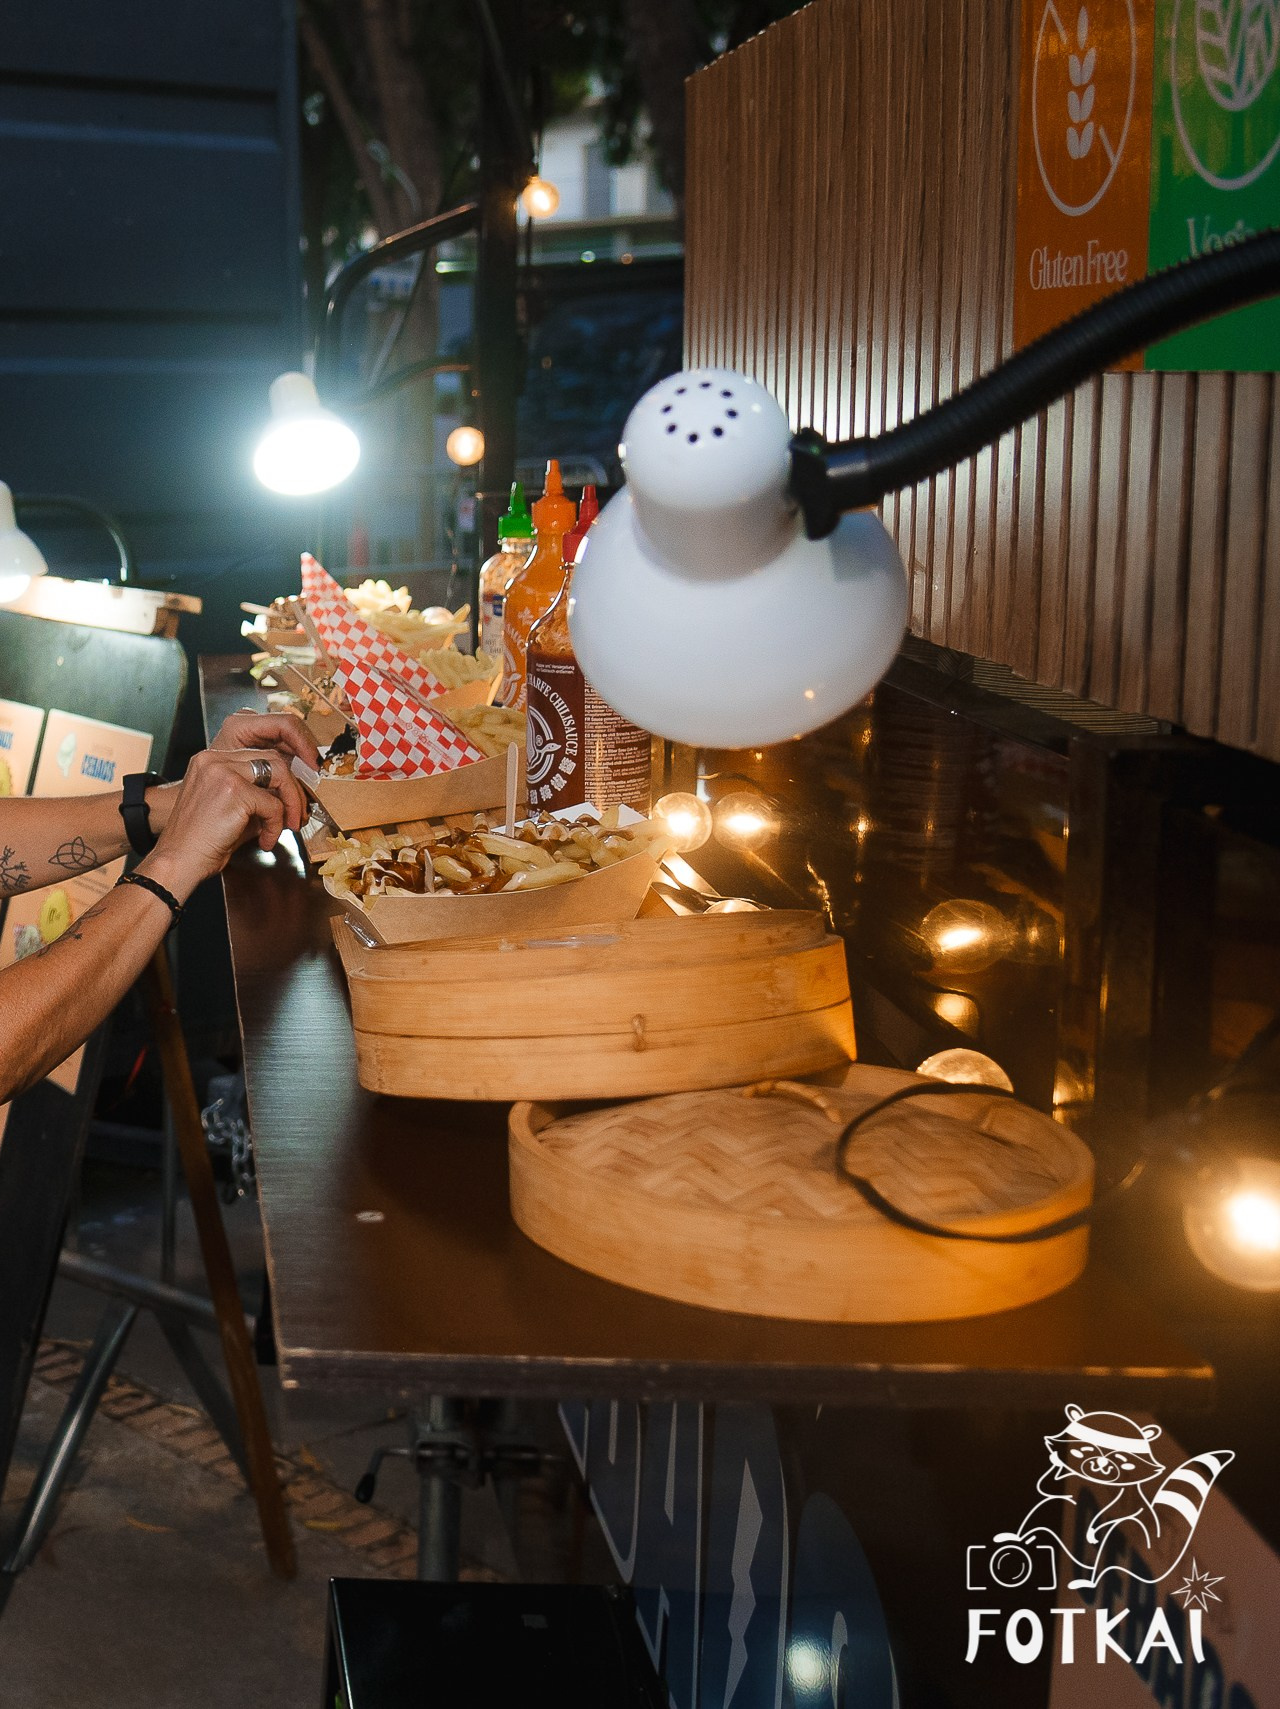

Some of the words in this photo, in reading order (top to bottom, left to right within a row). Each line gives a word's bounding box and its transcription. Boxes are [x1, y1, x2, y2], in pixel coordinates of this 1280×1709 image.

[1029, 246, 1083, 290] Gluten
[1087, 239, 1129, 284] Free
[549, 692, 578, 757] CHILISAUCE
